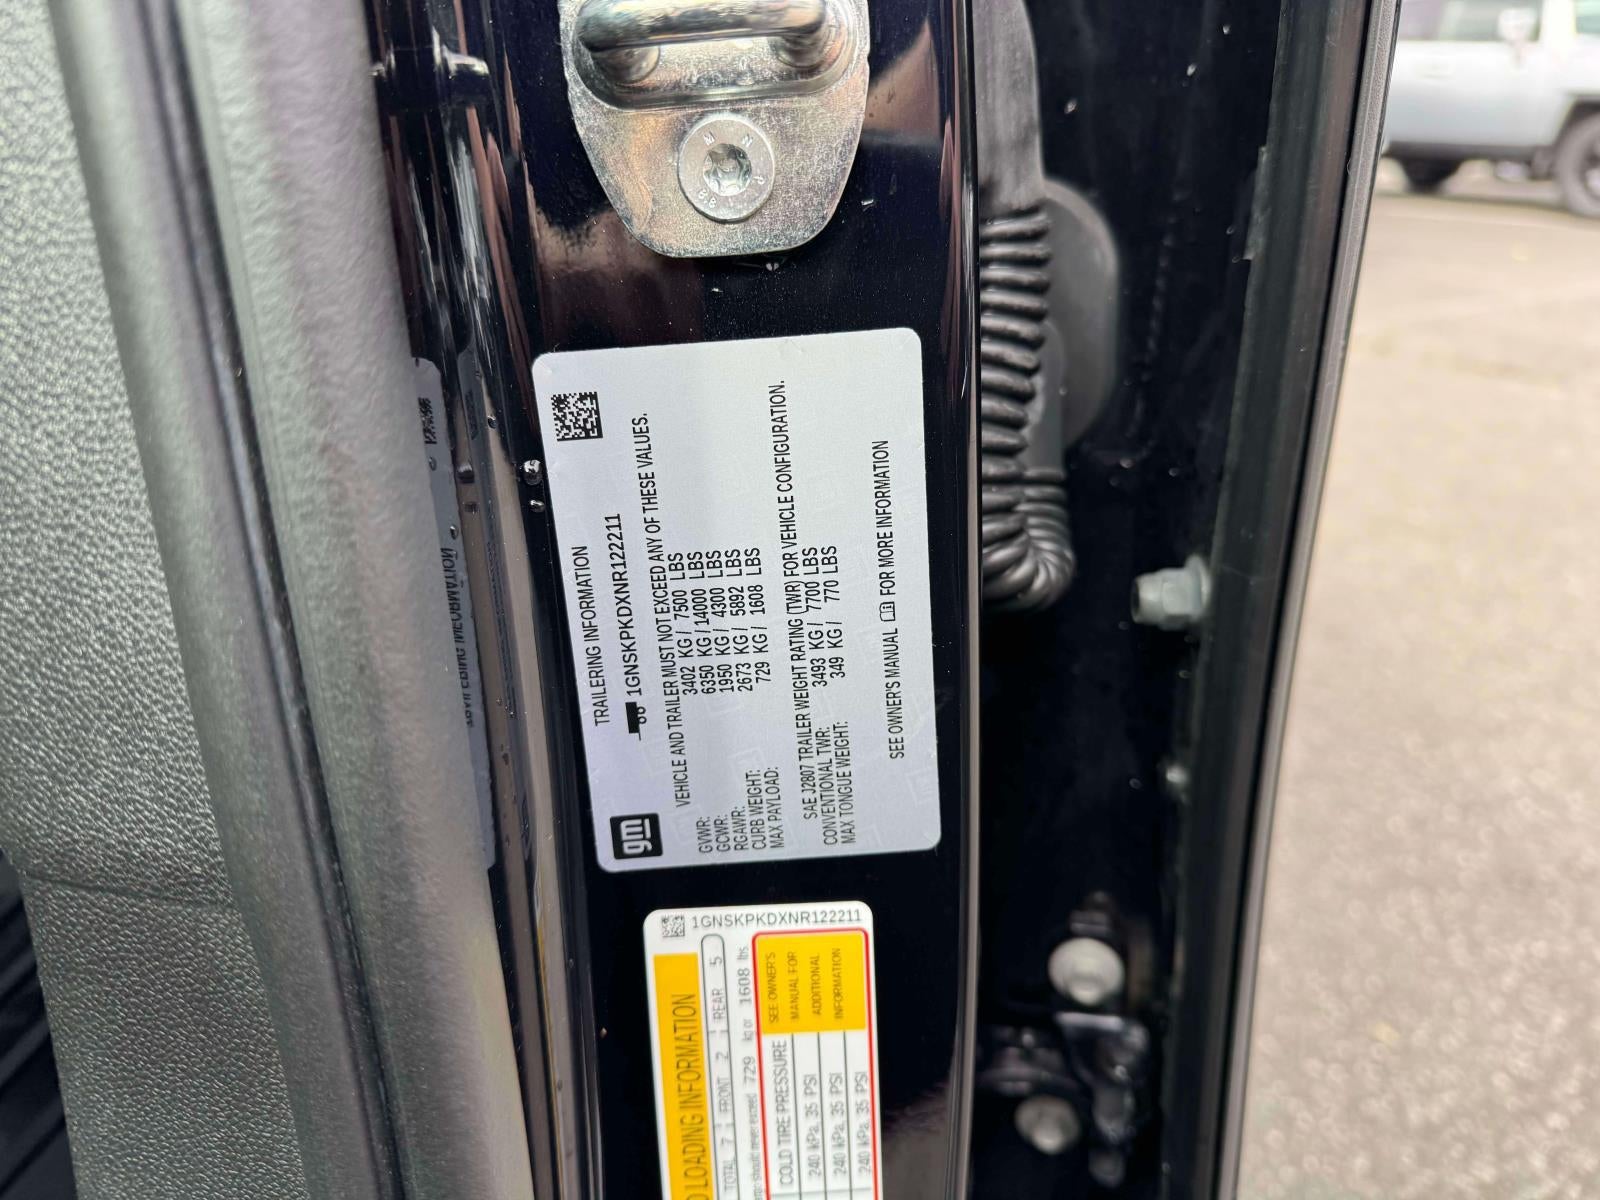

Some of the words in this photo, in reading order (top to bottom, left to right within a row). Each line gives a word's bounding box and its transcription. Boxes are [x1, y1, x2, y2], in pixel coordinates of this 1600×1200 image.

[632, 412, 654, 468] VALUES.
[767, 379, 794, 492] CONFIGURATION.
[638, 470, 659, 513] THESE
[870, 439, 893, 528] INFORMATION
[643, 515, 661, 533] OF
[776, 494, 798, 549] VEHICLE
[645, 536, 664, 562] ANY
[704, 549, 724, 578] LBS
[724, 547, 743, 577] LBS
[743, 546, 762, 575] LBS
[781, 551, 800, 577] FOR
[800, 546, 819, 575] LBS
[820, 544, 838, 574] LBS
[876, 530, 895, 567] MORE
[667, 551, 686, 580] LBS
[686, 550, 705, 579] LBS
[571, 545, 600, 641] INFORMATION
[649, 565, 670, 614] EXCEED
[783, 579, 806, 615] (TWR)
[803, 580, 822, 611] 7700
[822, 579, 840, 602] 770
[878, 570, 897, 596] FOR
[604, 513, 642, 696] 1GNSKPKDXNR122211
[671, 589, 690, 620] 7500
[690, 587, 709, 626] 14000
[708, 586, 728, 617] 4300
[727, 585, 746, 616] 5892
[746, 584, 765, 615] 1608
[654, 616, 673, 641] NOT
[786, 618, 807, 661] RATING
[658, 644, 677, 677] MUST
[828, 655, 845, 678] 349
[881, 627, 901, 678] MANUAL
[584, 645, 611, 726] TRAILERING
[679, 665, 698, 695] 3402
[698, 663, 716, 694] 6350
[716, 662, 735, 693] 1950
[734, 661, 753, 692] 2673
[753, 660, 771, 683] 729
[790, 663, 810, 710] WEIGHT
[809, 657, 827, 687] 3493
[661, 679, 682, 729] TRAILER
[884, 680, 904, 734] OWNER'S
[667, 731, 685, 755] AND
[794, 712, 814, 761] TRAILER
[814, 726, 832, 755] TWR:
[832, 720, 851, 768] WEIGHT:
[888, 736, 905, 759] SEE
[670, 758, 691, 807] VEHICLE
[744, 768, 764, 815] WEIGHT:
[763, 766, 783, 822] PAYLOAD:
[798, 763, 817, 794] J2807
[836, 770, 855, 817] TONGUE
[801, 796, 819, 819] SAE
[816, 758, 839, 845] CONVENTIONAL
[695, 815, 714, 853] GVWR:
[713, 814, 732, 852] GCWR:
[730, 805, 750, 851] RGAWR:
[749, 817, 767, 850] CURB
[768, 824, 785, 848] MAX
[839, 819, 856, 843] MAX
[691, 908, 861, 928] 1GNSKPKDXNR122211
[709, 955, 724, 966] 5
[765, 951, 778, 1000] OWNER'S
[787, 950, 798, 973] FOR
[737, 967, 752, 1004] 1608
[788, 976, 800, 1020] MANUAL
[809, 953, 823, 1015] ADDITIONAL
[831, 947, 844, 1019] INFORMATION
[711, 987, 727, 1019] REAR
[767, 1003, 779, 1023] SEE
[671, 992, 703, 1108] INFORMATION
[715, 1051, 729, 1060] 2
[741, 1055, 756, 1085] 729
[772, 1039, 790, 1112] PRESSURE
[803, 1072, 818, 1095] PSI
[828, 1072, 844, 1094] PSI
[854, 1071, 868, 1092] PSI
[804, 1102, 819, 1117] 35
[830, 1100, 845, 1116] 35
[855, 1099, 869, 1114] 35
[776, 1115, 792, 1145] TIRE
[679, 1113, 707, 1187] LOADING
[806, 1154, 821, 1176] 240
[832, 1152, 847, 1175] 240
[857, 1151, 871, 1173] 240
[777, 1149, 793, 1185] COLD
